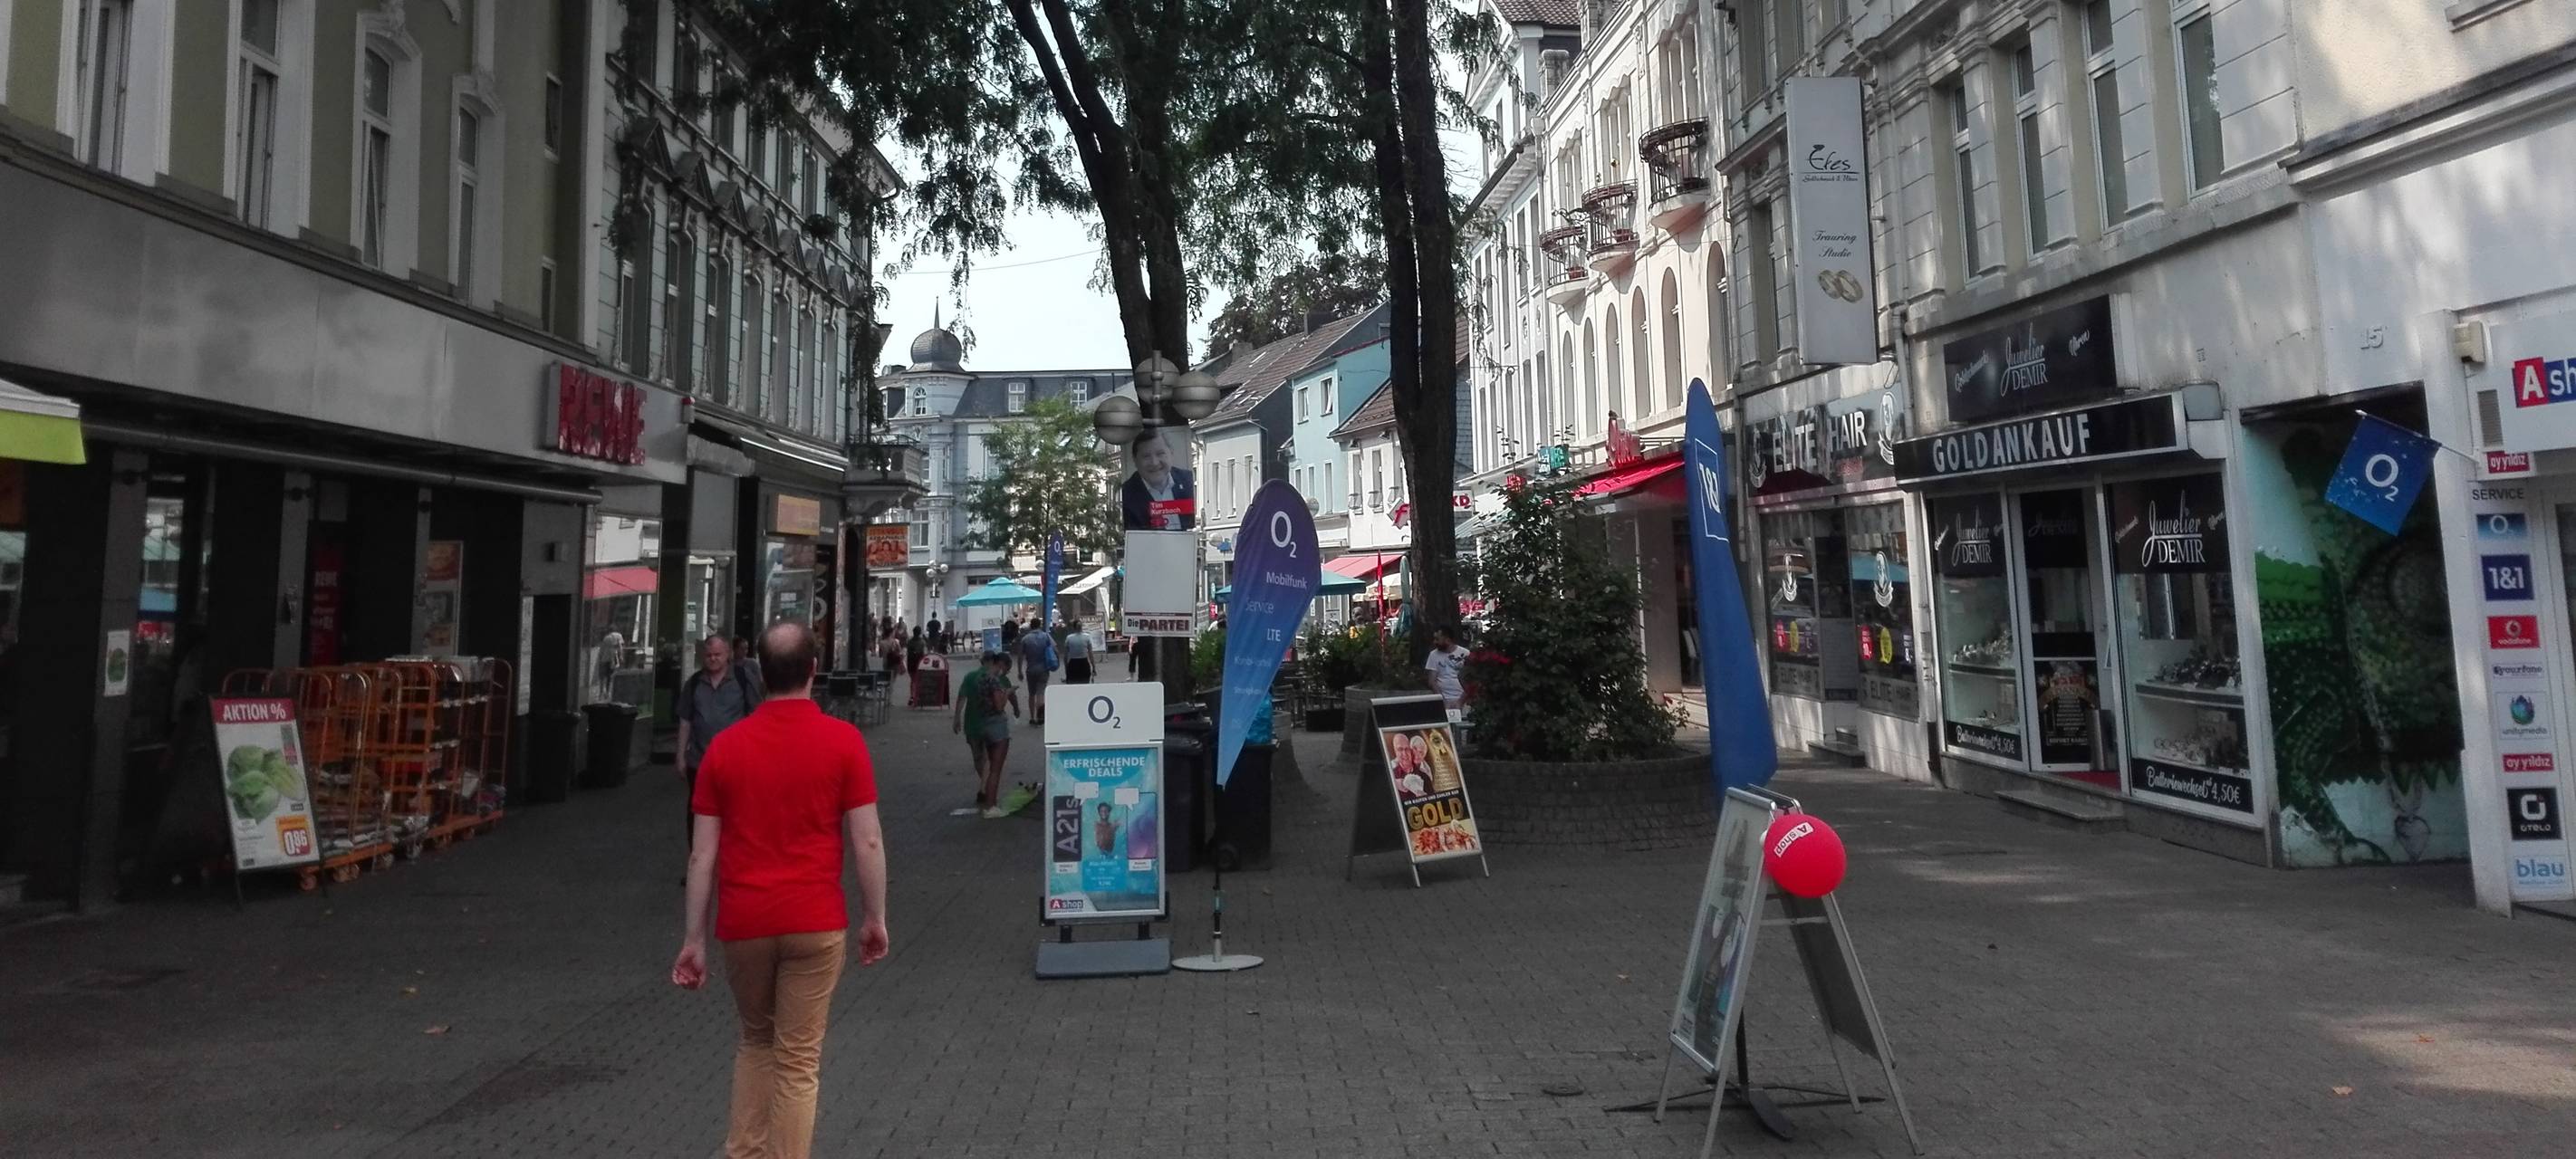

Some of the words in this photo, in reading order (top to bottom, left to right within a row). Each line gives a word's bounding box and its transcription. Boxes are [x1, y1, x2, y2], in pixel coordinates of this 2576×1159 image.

[1806, 145, 1851, 170] Efes
[1812, 230, 1858, 244] Trauring
[1818, 246, 1852, 258] Studio
[2360, 323, 2388, 350] 15
[2000, 321, 2045, 398] Juwelier
[2012, 362, 2049, 390] DEMIR
[2522, 365, 2544, 401] A
[1773, 422, 1818, 474] ELITE
[1828, 410, 1868, 453] HAIR
[1933, 413, 2091, 474] GOLDANKAUF
[2472, 487, 2525, 501] SERVICE
[1271, 511, 1297, 558] O2
[1951, 505, 1990, 567] Juwelier
[2141, 489, 2202, 568] Juwelier
[1962, 543, 1993, 564] DEMIR
[2157, 539, 2206, 563] DEMIR
[1266, 572, 1308, 589] Mobilfunk
[2488, 567, 2525, 589] 1&1
[1128, 618, 1139, 627] Die
[1139, 619, 1189, 632] PARTEI
[1267, 627, 1282, 642] LTE
[223, 704, 269, 721] AKTION
[270, 703, 286, 719] %
[1087, 695, 1121, 729] O2
[1063, 756, 1146, 769] ERFRISCHENDE
[1089, 767, 1123, 777] DEALS
[2211, 782, 2241, 805] 4,50€
[1407, 797, 1465, 830] GOLD
[1056, 798, 1080, 854] A21s
[1797, 824, 1808, 834] A
[1775, 831, 1797, 855] shop
[2516, 859, 2565, 878] blau
[1062, 900, 1082, 909] shop
